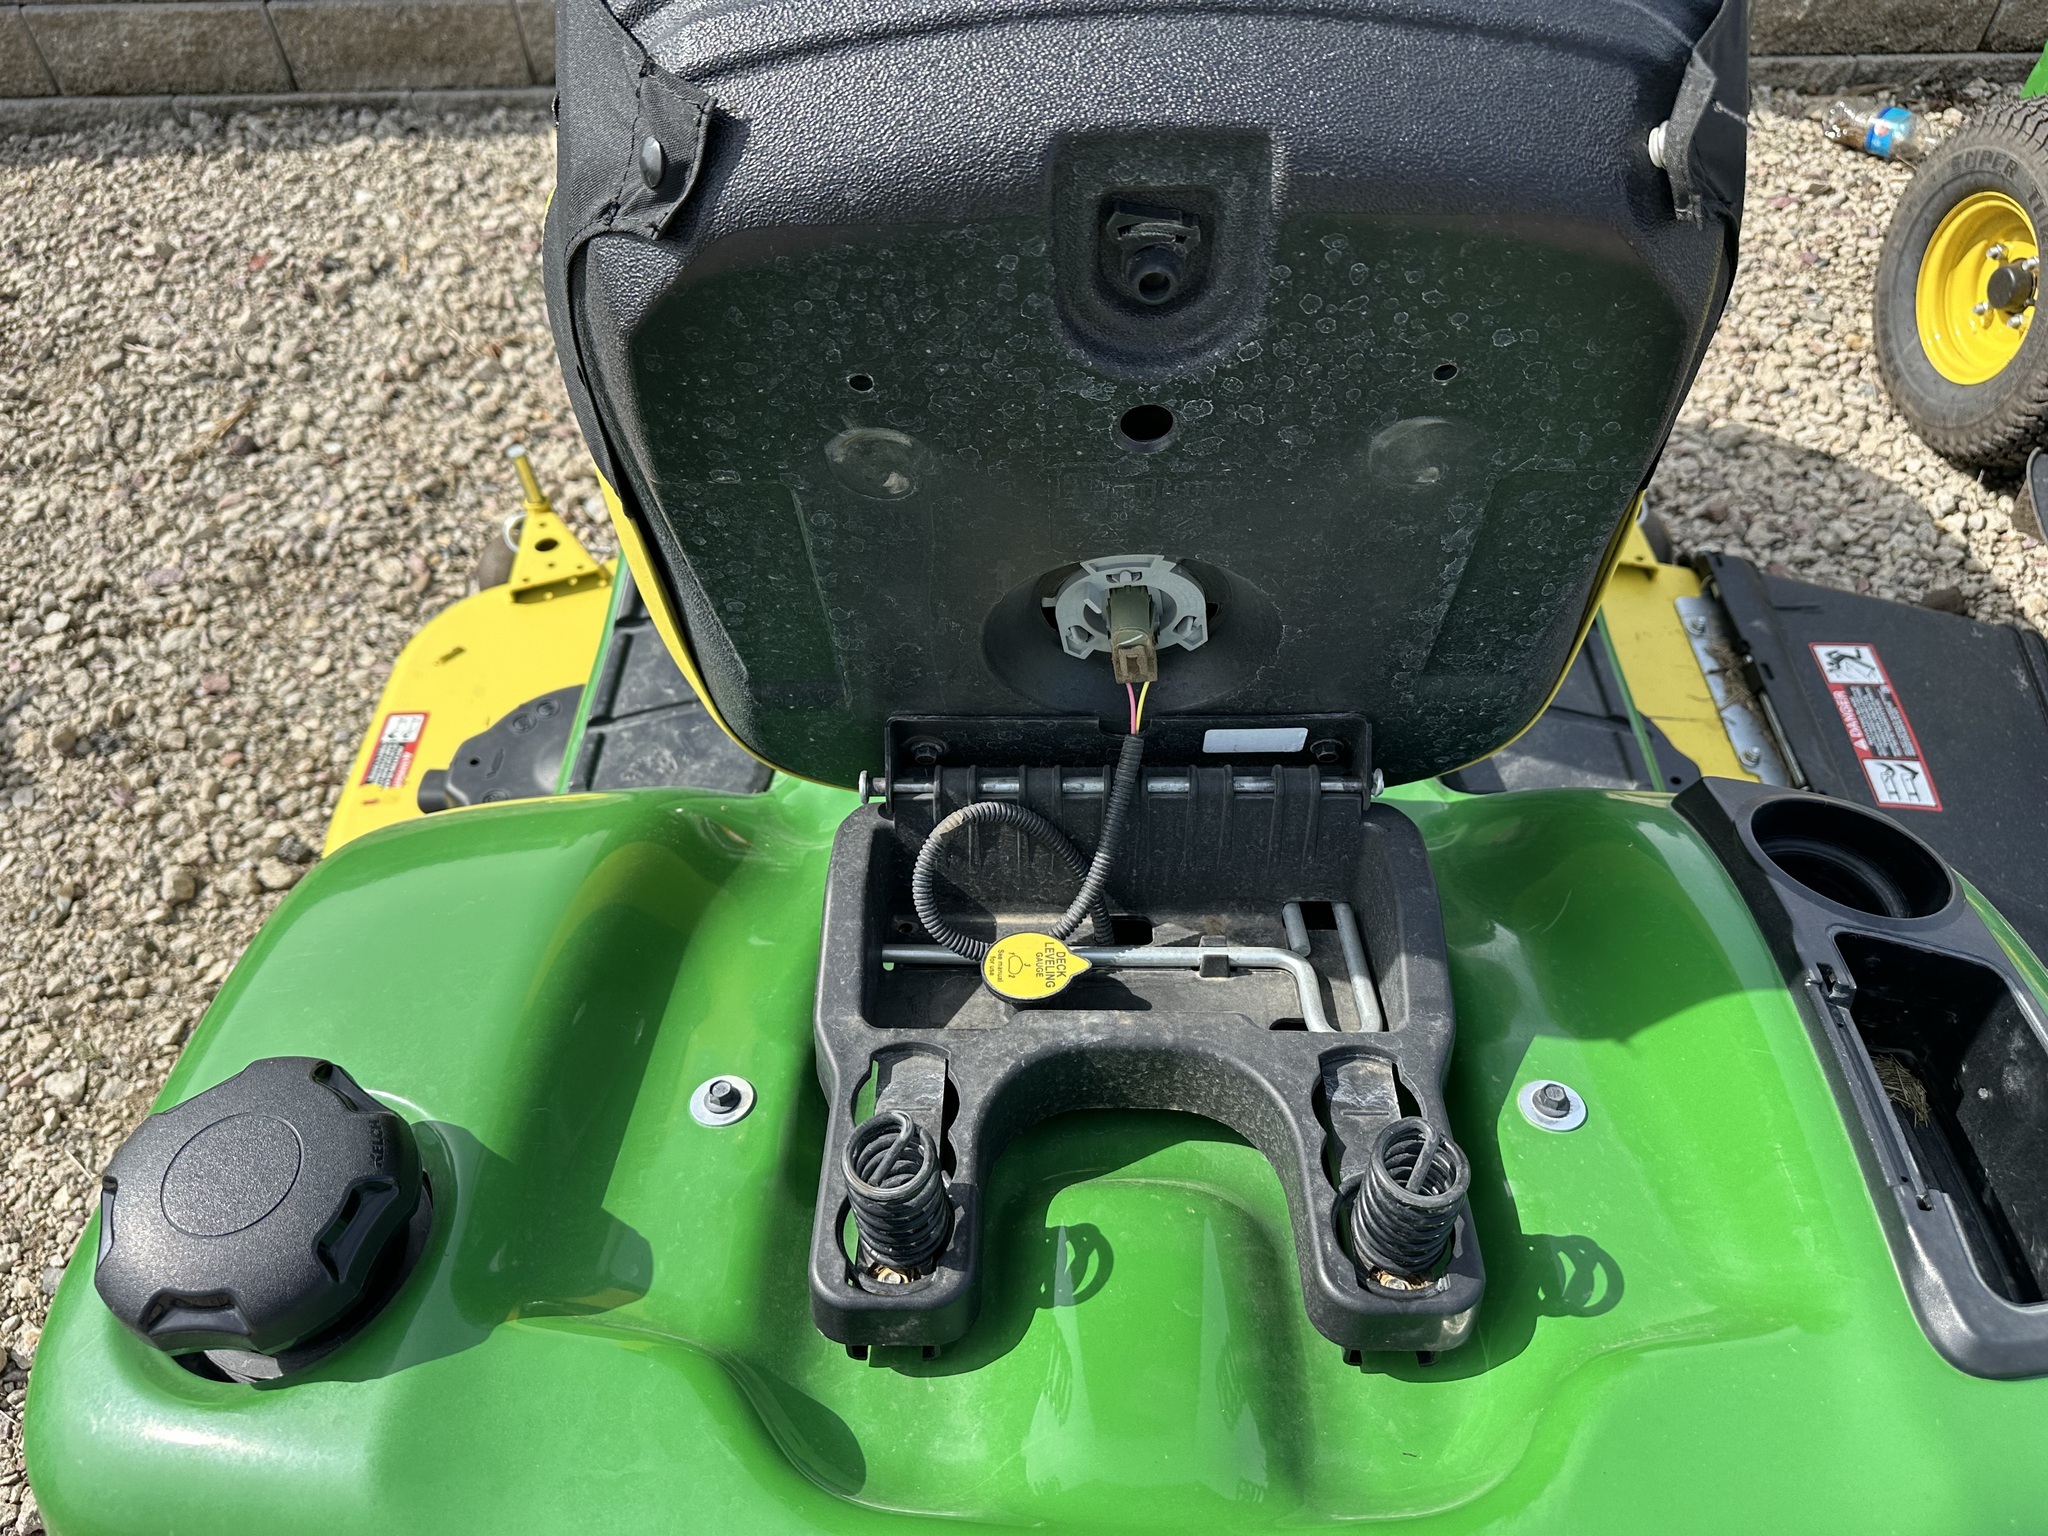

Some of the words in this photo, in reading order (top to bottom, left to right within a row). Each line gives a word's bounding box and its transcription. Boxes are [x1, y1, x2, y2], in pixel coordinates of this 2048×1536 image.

[1951, 149, 2018, 179] SUPER
[1832, 690, 1863, 738] DANGER
[1045, 942, 1056, 988] LEVELING
[1056, 952, 1066, 978] DECK
